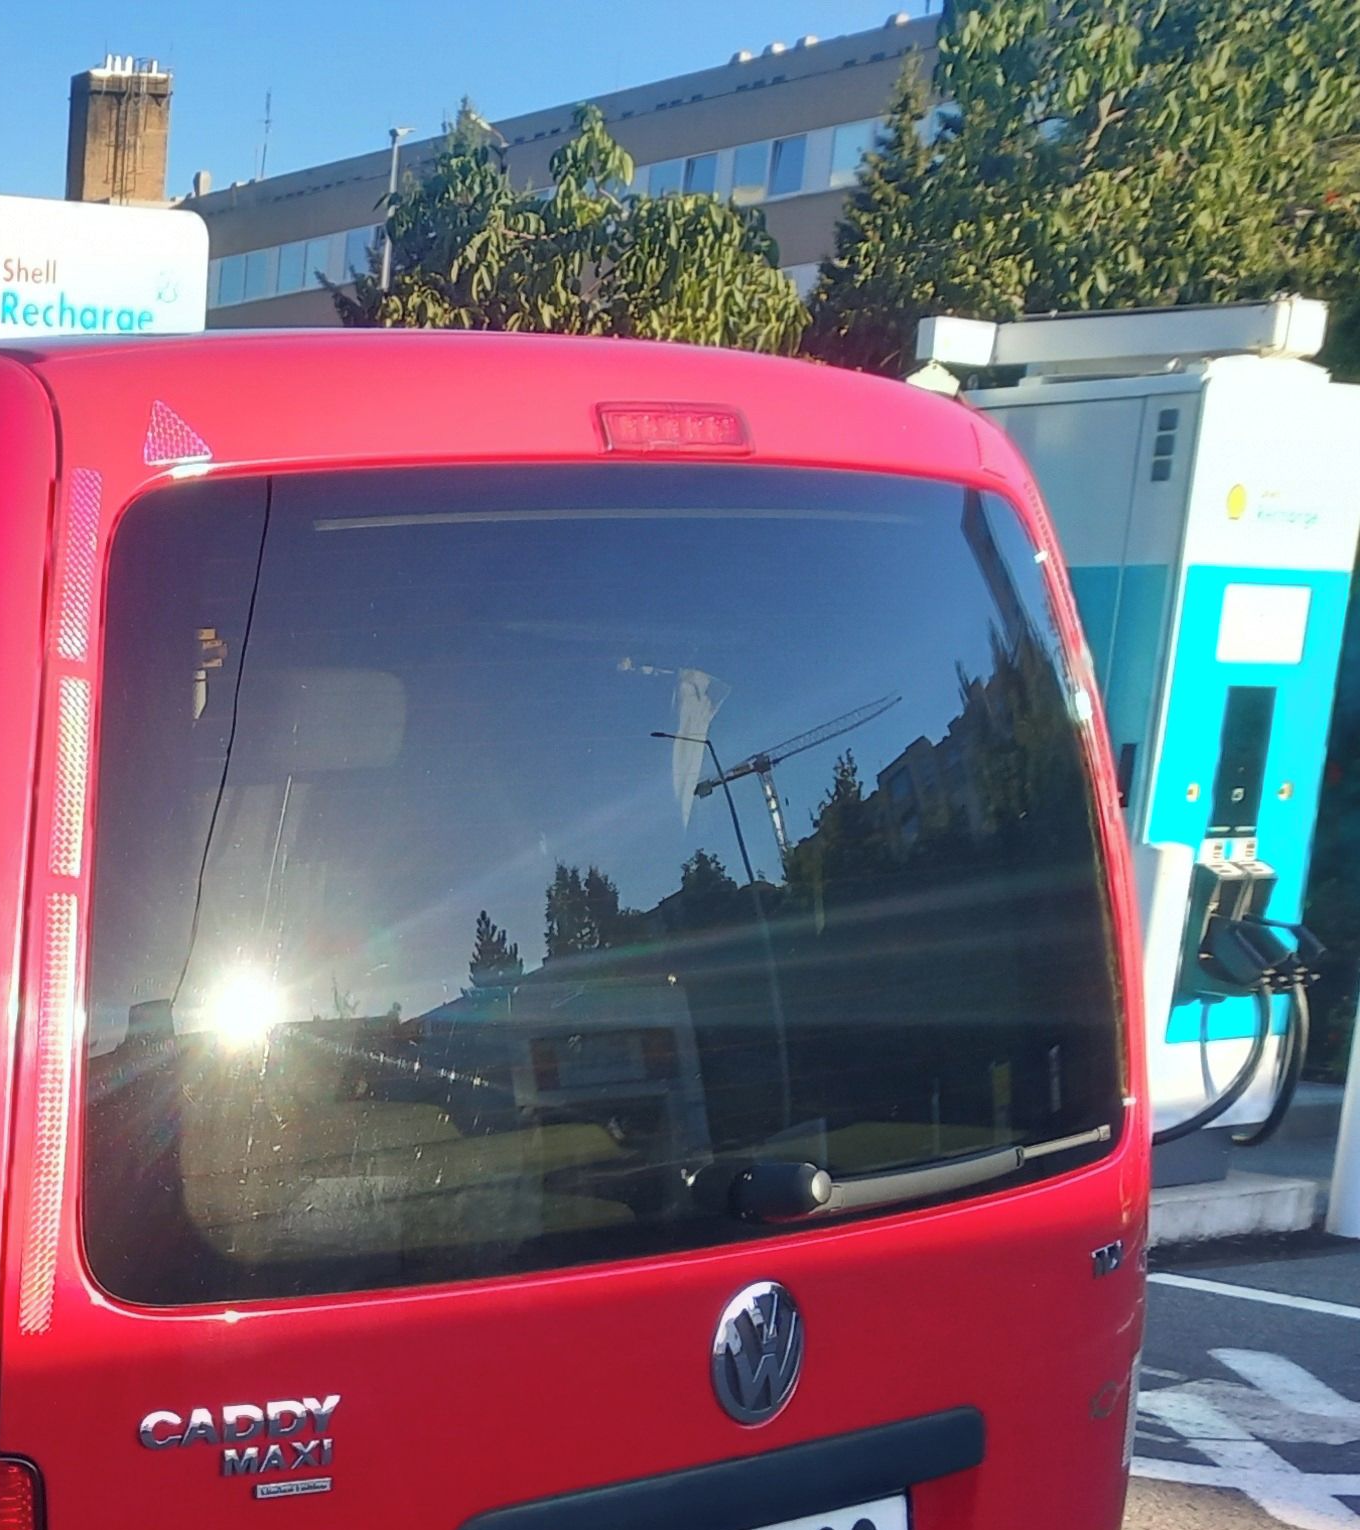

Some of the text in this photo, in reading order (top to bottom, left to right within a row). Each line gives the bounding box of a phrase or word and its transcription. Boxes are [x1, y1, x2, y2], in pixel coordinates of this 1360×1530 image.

[2, 257, 57, 284] Shell
[139, 1394, 341, 1450] CADDY
[222, 1438, 334, 1477] MAXI
